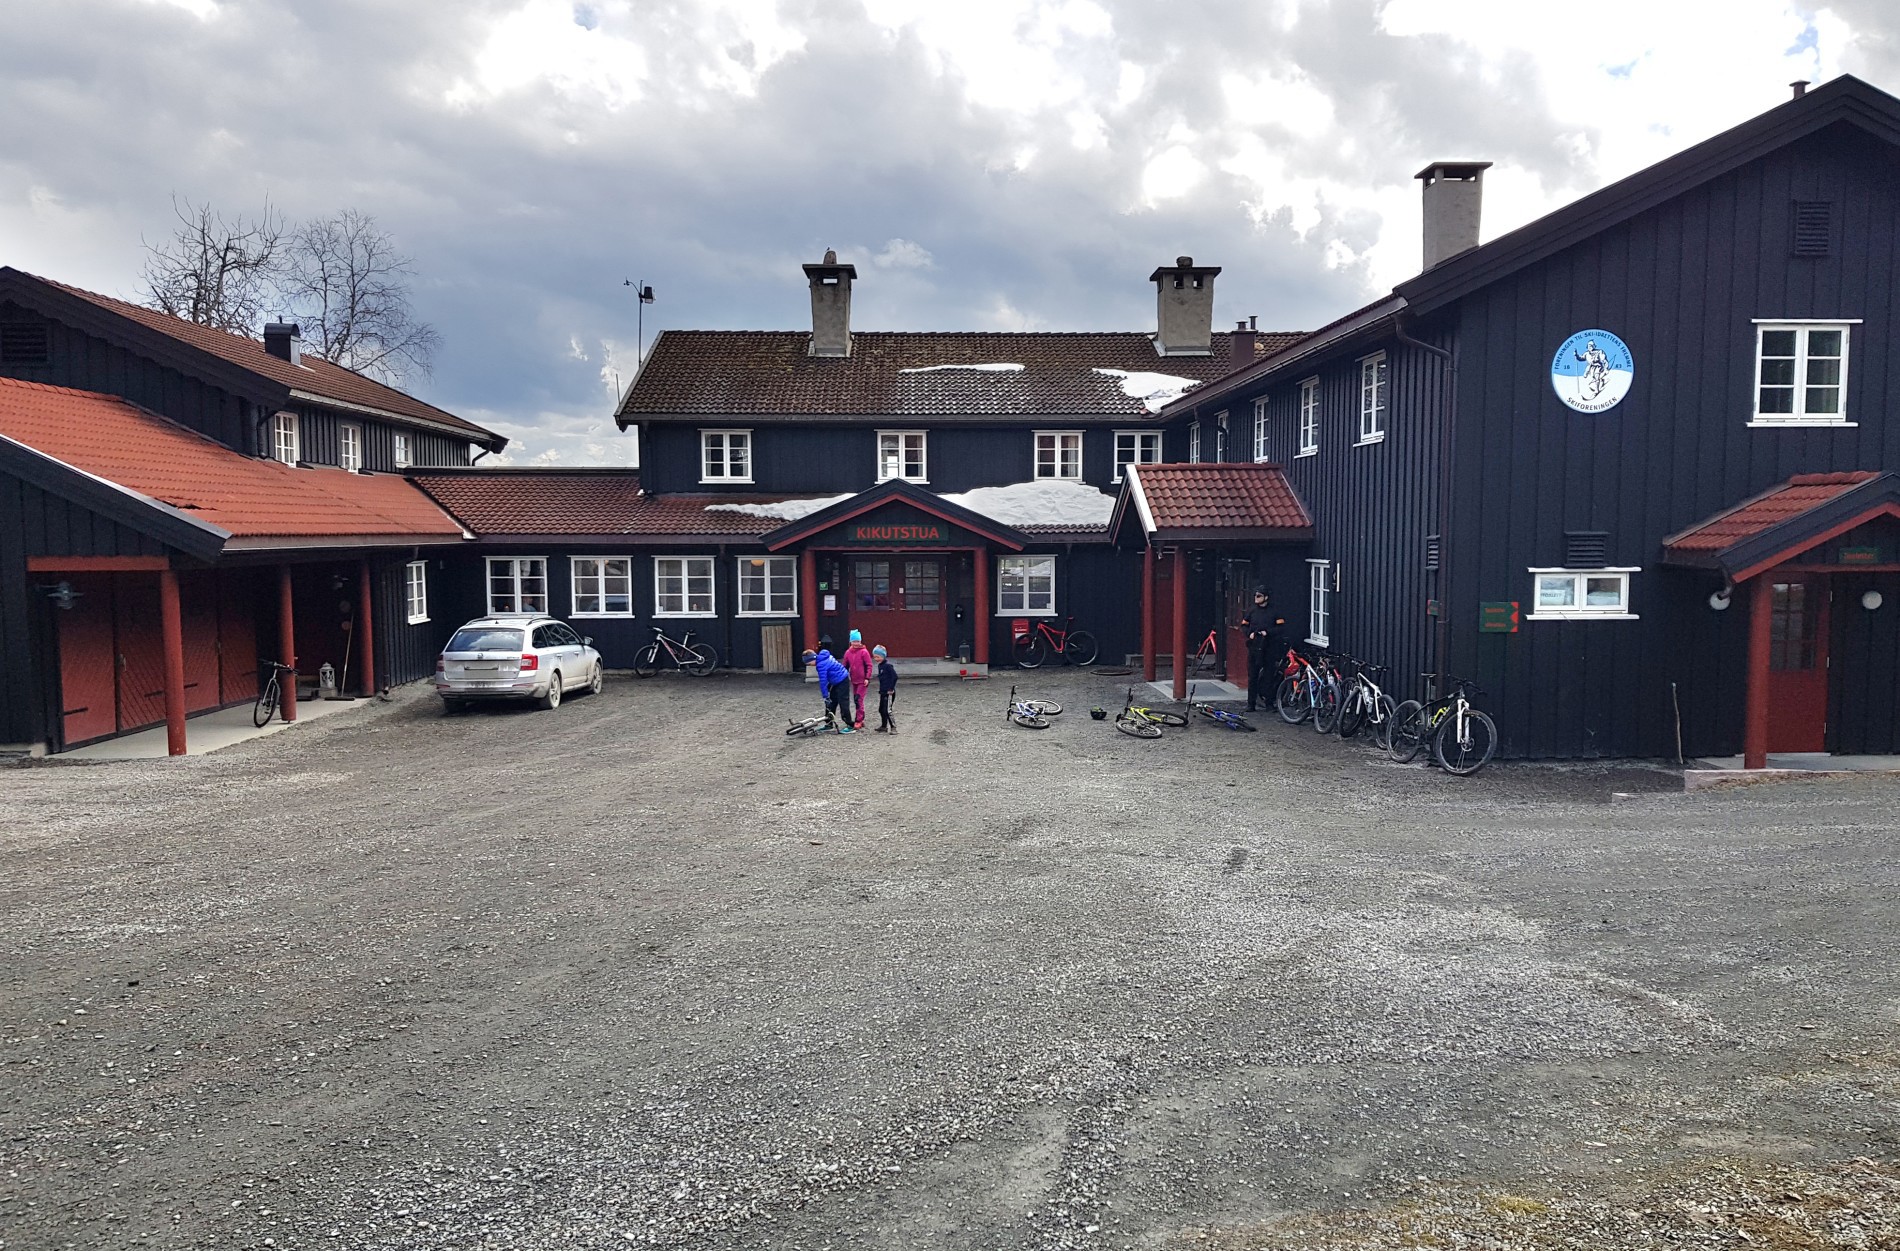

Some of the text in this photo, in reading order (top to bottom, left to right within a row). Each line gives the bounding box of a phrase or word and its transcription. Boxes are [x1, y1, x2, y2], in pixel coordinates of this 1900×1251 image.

[1555, 340, 1574, 369] FORENINGEN
[1621, 346, 1631, 368] FREMME
[1567, 396, 1618, 410] SKIFORENINGEN
[856, 525, 940, 539] KIKUTSTUA
